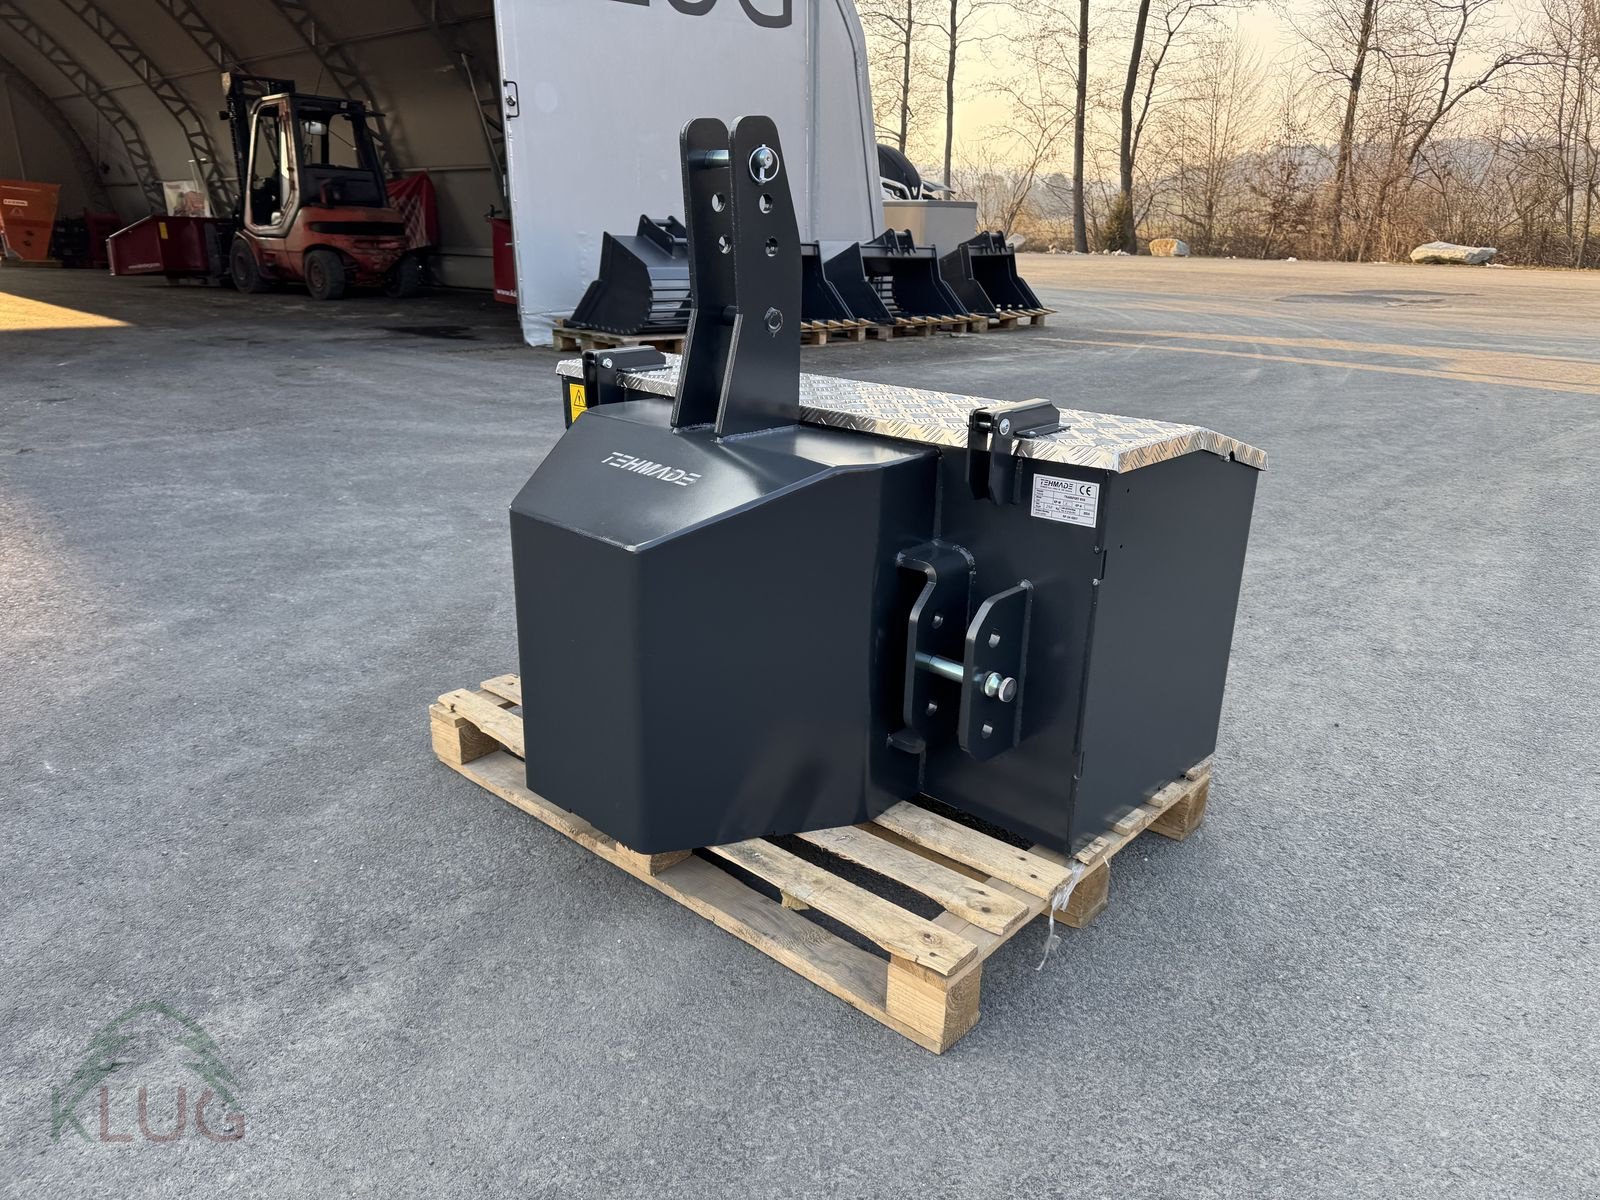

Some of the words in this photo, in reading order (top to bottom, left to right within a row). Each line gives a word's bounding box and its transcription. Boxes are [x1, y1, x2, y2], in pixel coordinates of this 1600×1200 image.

[601, 451, 702, 487] TEHMADE
[1040, 478, 1073, 490] TEHMADE
[1079, 485, 1092, 497] CE
